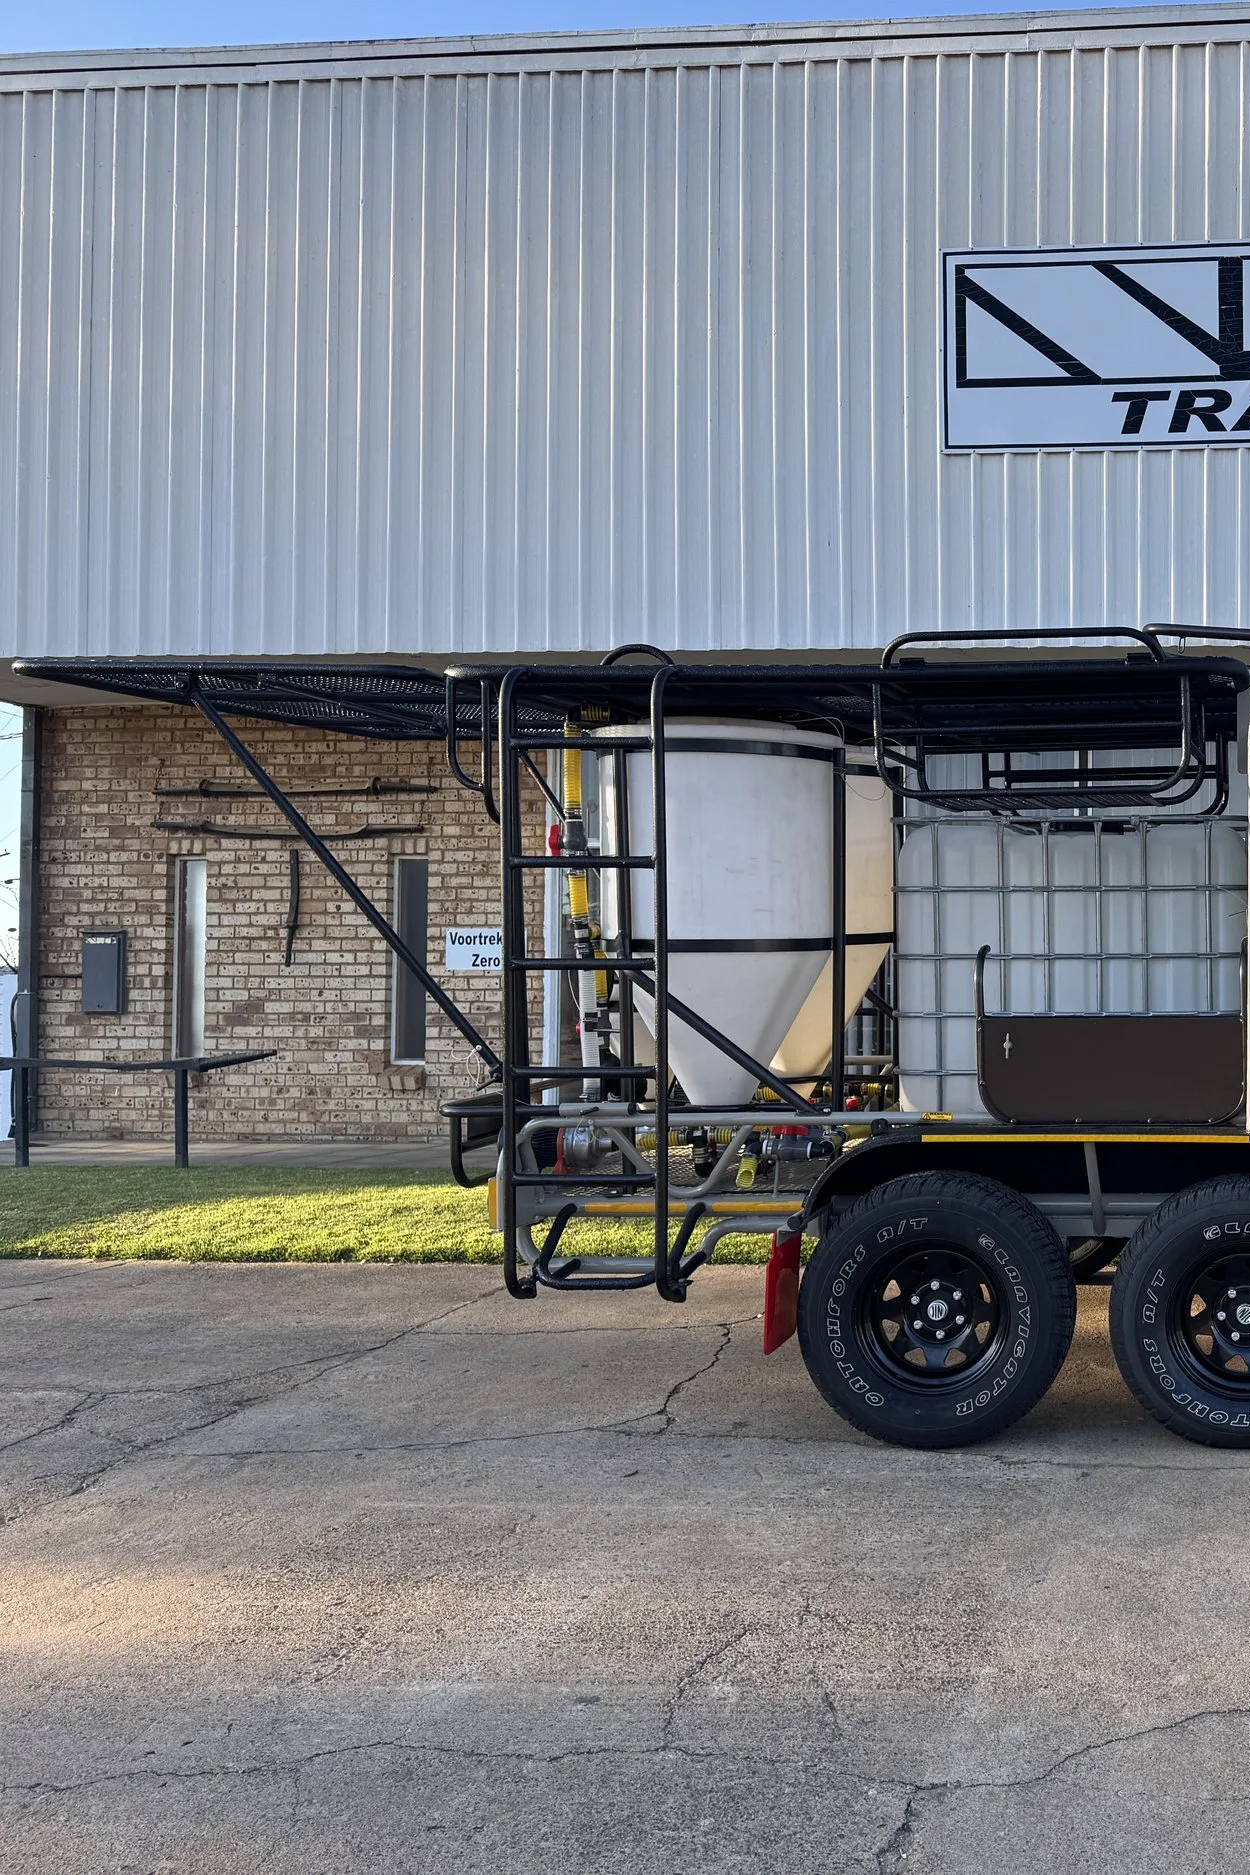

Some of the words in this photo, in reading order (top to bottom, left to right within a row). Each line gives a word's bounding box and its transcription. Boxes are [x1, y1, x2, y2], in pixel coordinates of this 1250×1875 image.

[449, 932, 503, 946] Voortrek
[472, 954, 501, 967] Zero
[876, 1217, 928, 1244] A/T
[1142, 1268, 1166, 1324] A/T
